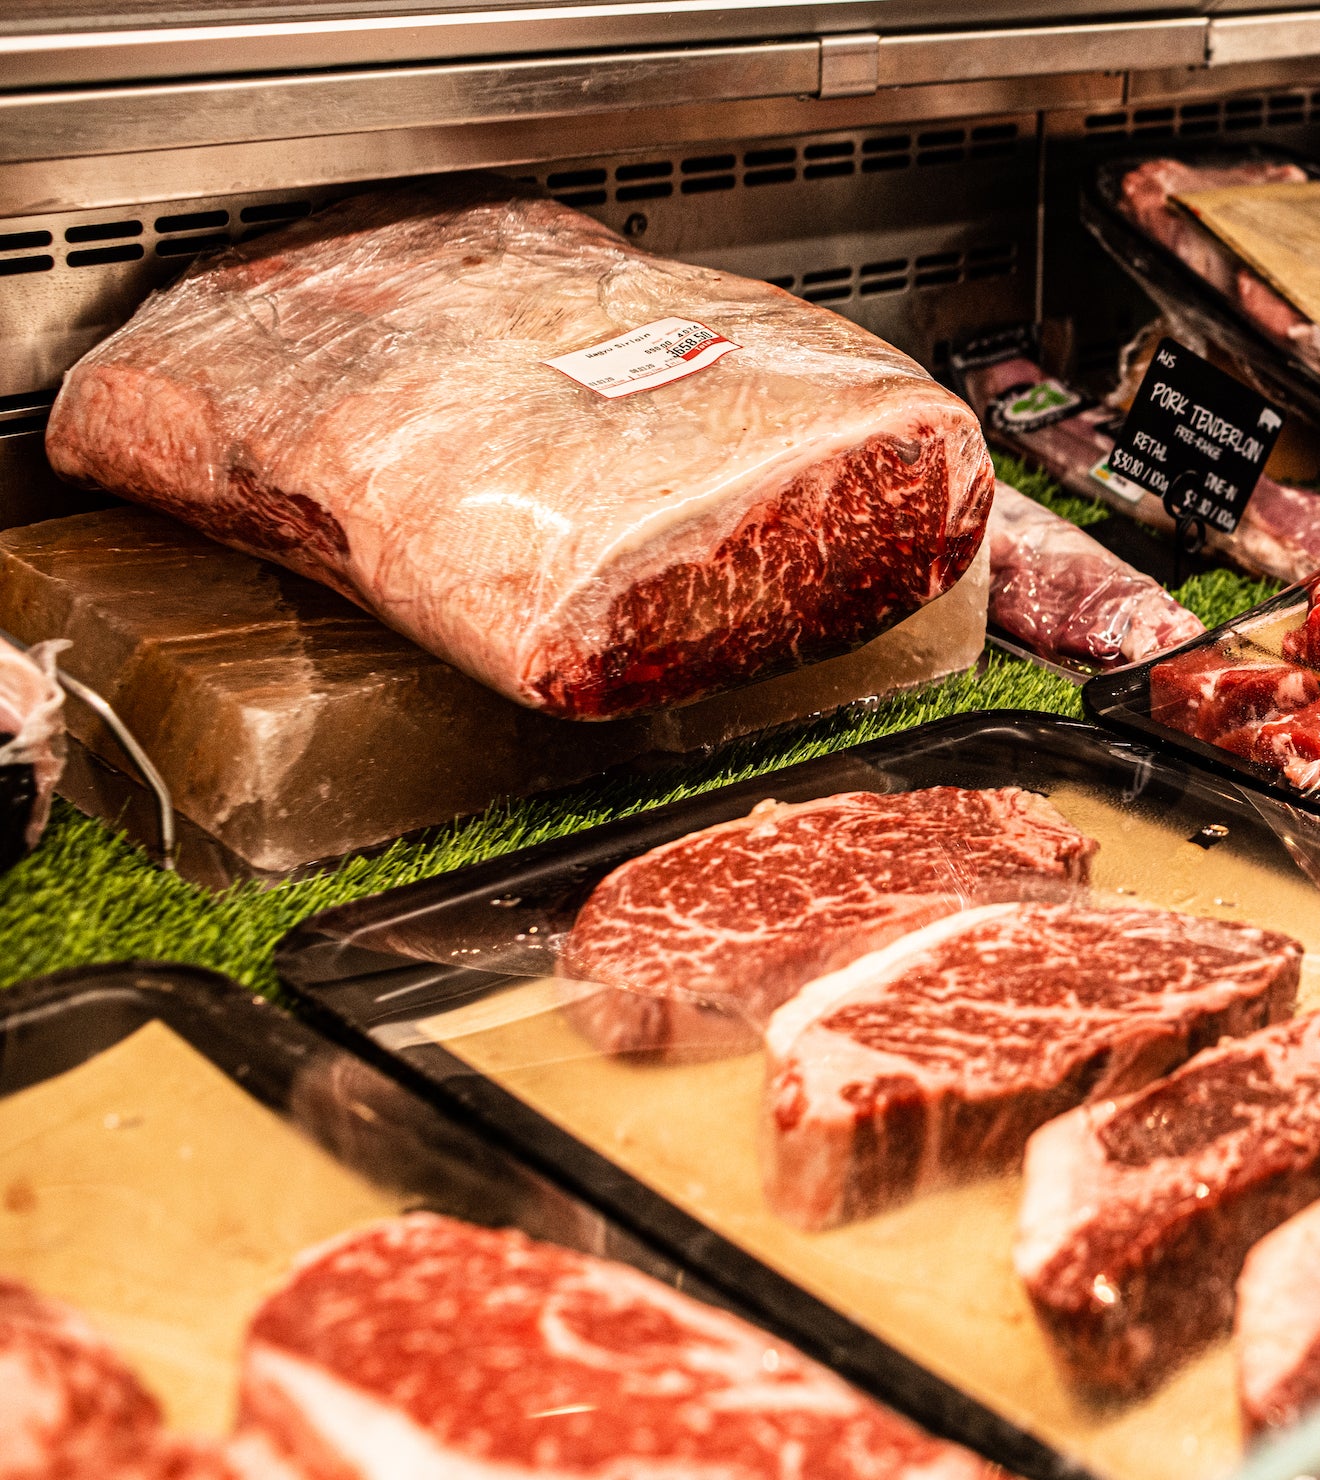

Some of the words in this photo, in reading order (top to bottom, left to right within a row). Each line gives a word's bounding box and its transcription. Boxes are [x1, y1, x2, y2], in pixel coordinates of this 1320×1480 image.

[585, 348, 613, 359] Wagyu
[614, 333, 651, 349] Sirloin
[695, 339, 714, 351] Total
[1156, 349, 1178, 369] AUS
[1150, 382, 1190, 416] PORK
[1189, 404, 1265, 464] TENDERLOIN
[1132, 430, 1168, 462] RETAIL
[1173, 424, 1224, 461] FREE-RANGE
